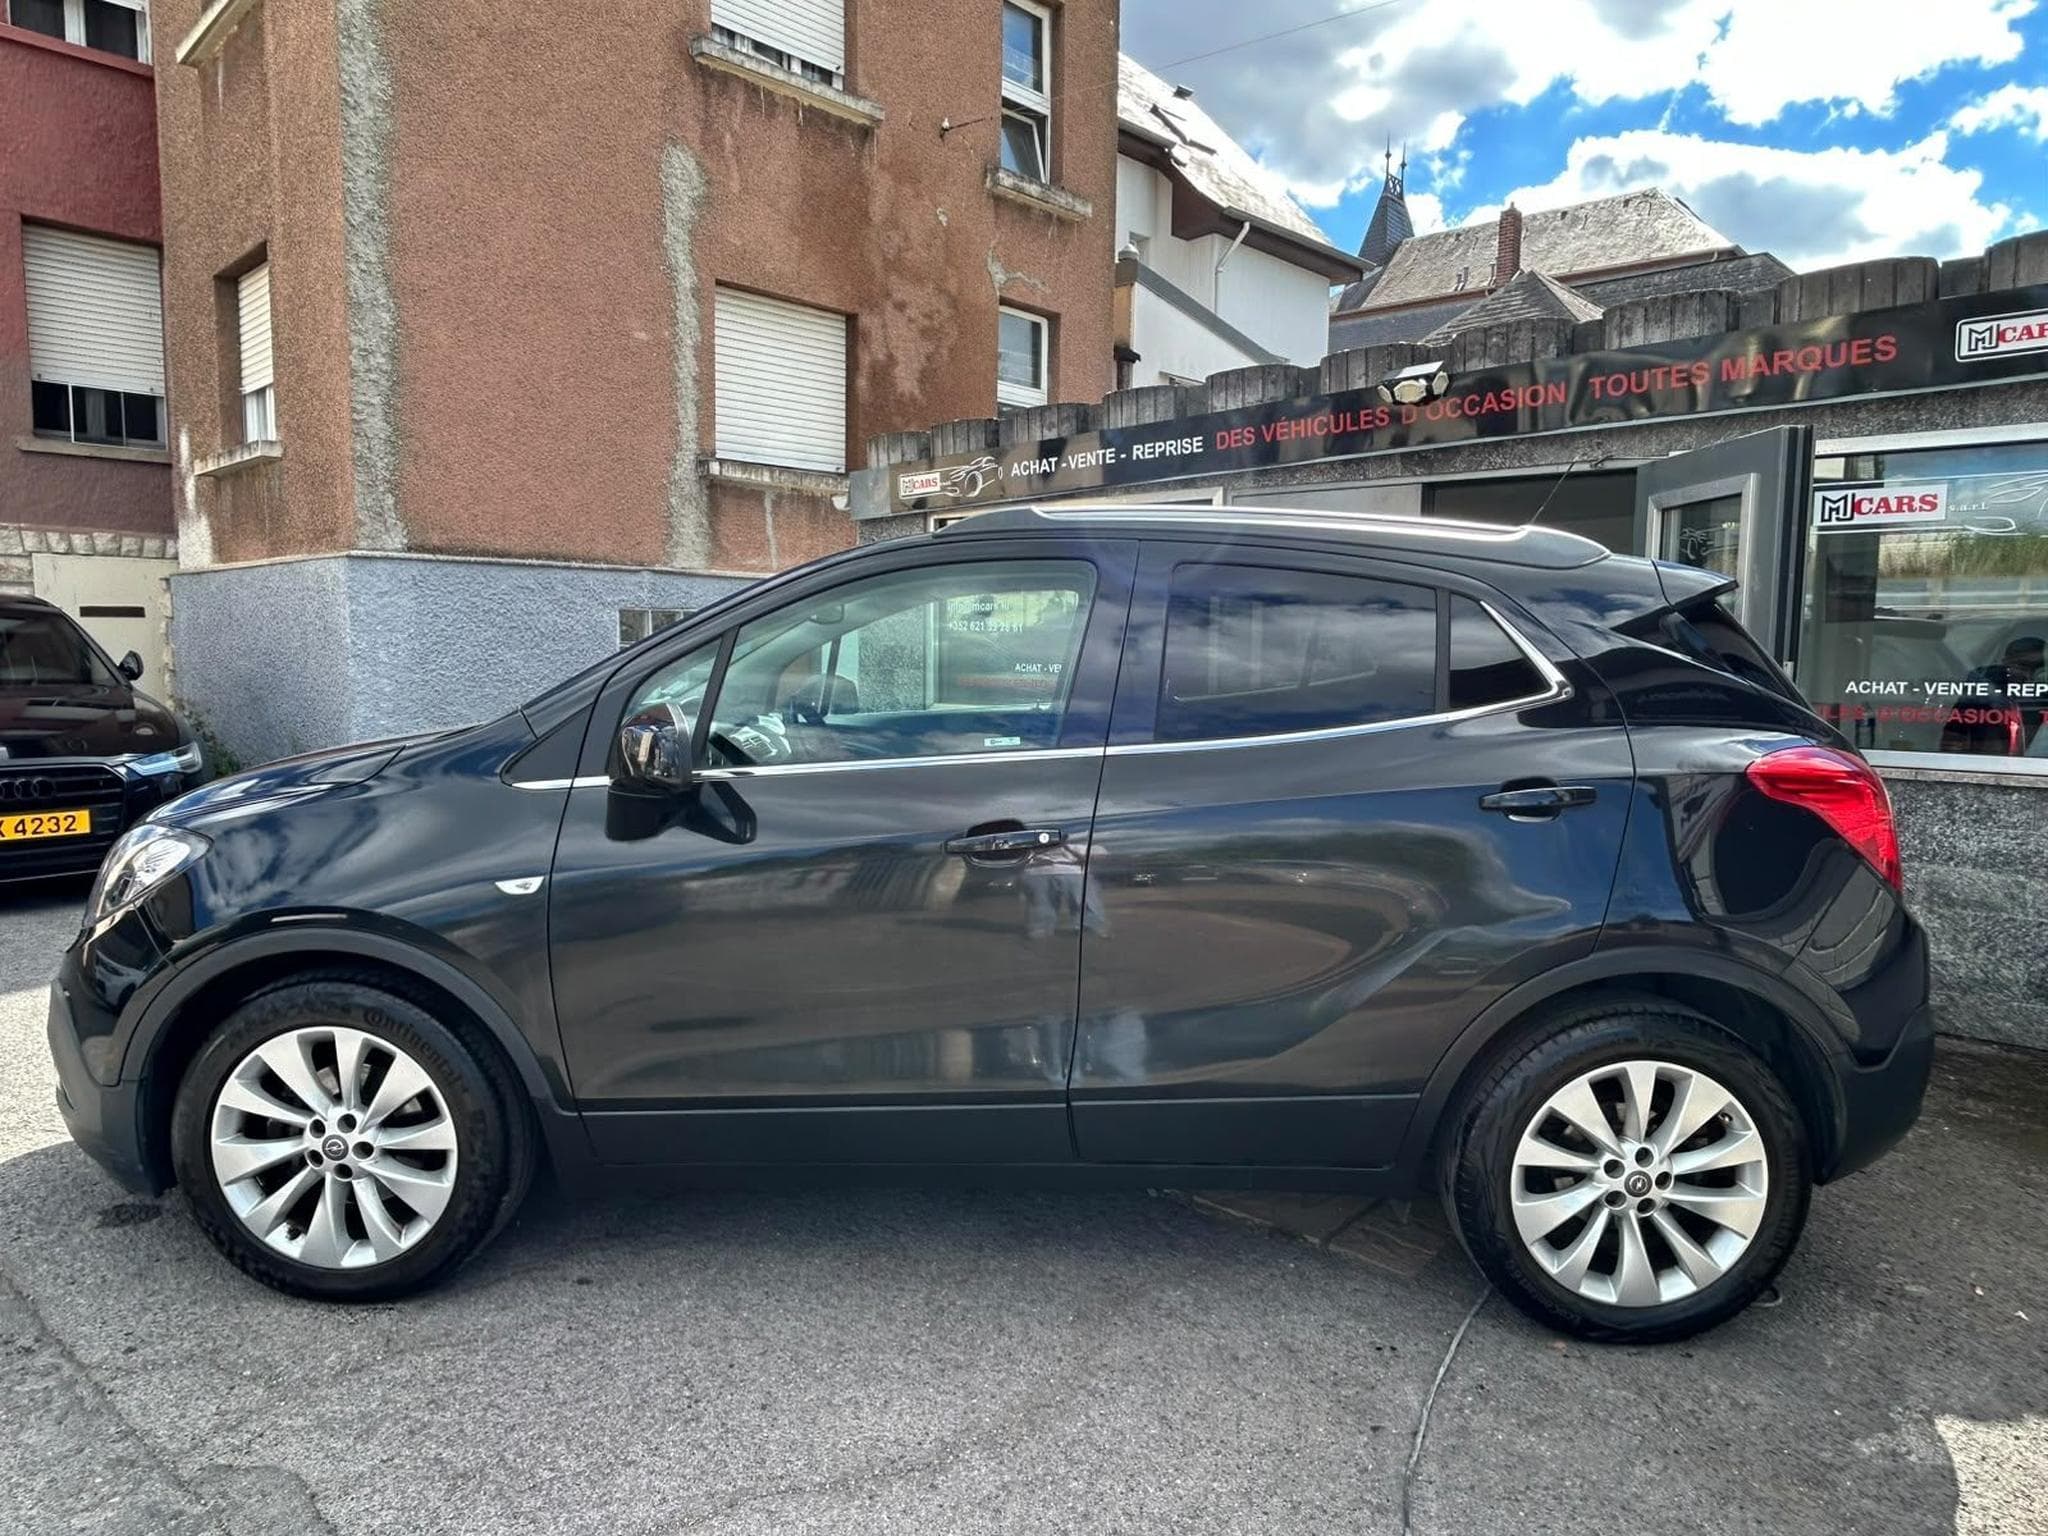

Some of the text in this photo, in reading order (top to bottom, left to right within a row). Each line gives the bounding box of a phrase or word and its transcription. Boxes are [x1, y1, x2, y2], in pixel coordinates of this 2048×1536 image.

[1011, 457, 1058, 478] ACHAT
[1068, 448, 1116, 471] VENTE
[1132, 436, 1204, 461] REPRISE
[1216, 427, 1256, 450] DES
[1261, 406, 1391, 442] VÉHICULES
[1588, 360, 1711, 400] TOUTES
[1720, 335, 1897, 383] MARQUES
[1014, 663, 1042, 673] ACHAT
[1845, 680, 1908, 695] ACHAT
[1924, 681, 1989, 696] VENTE
[14, 814, 78, 836] 4232
